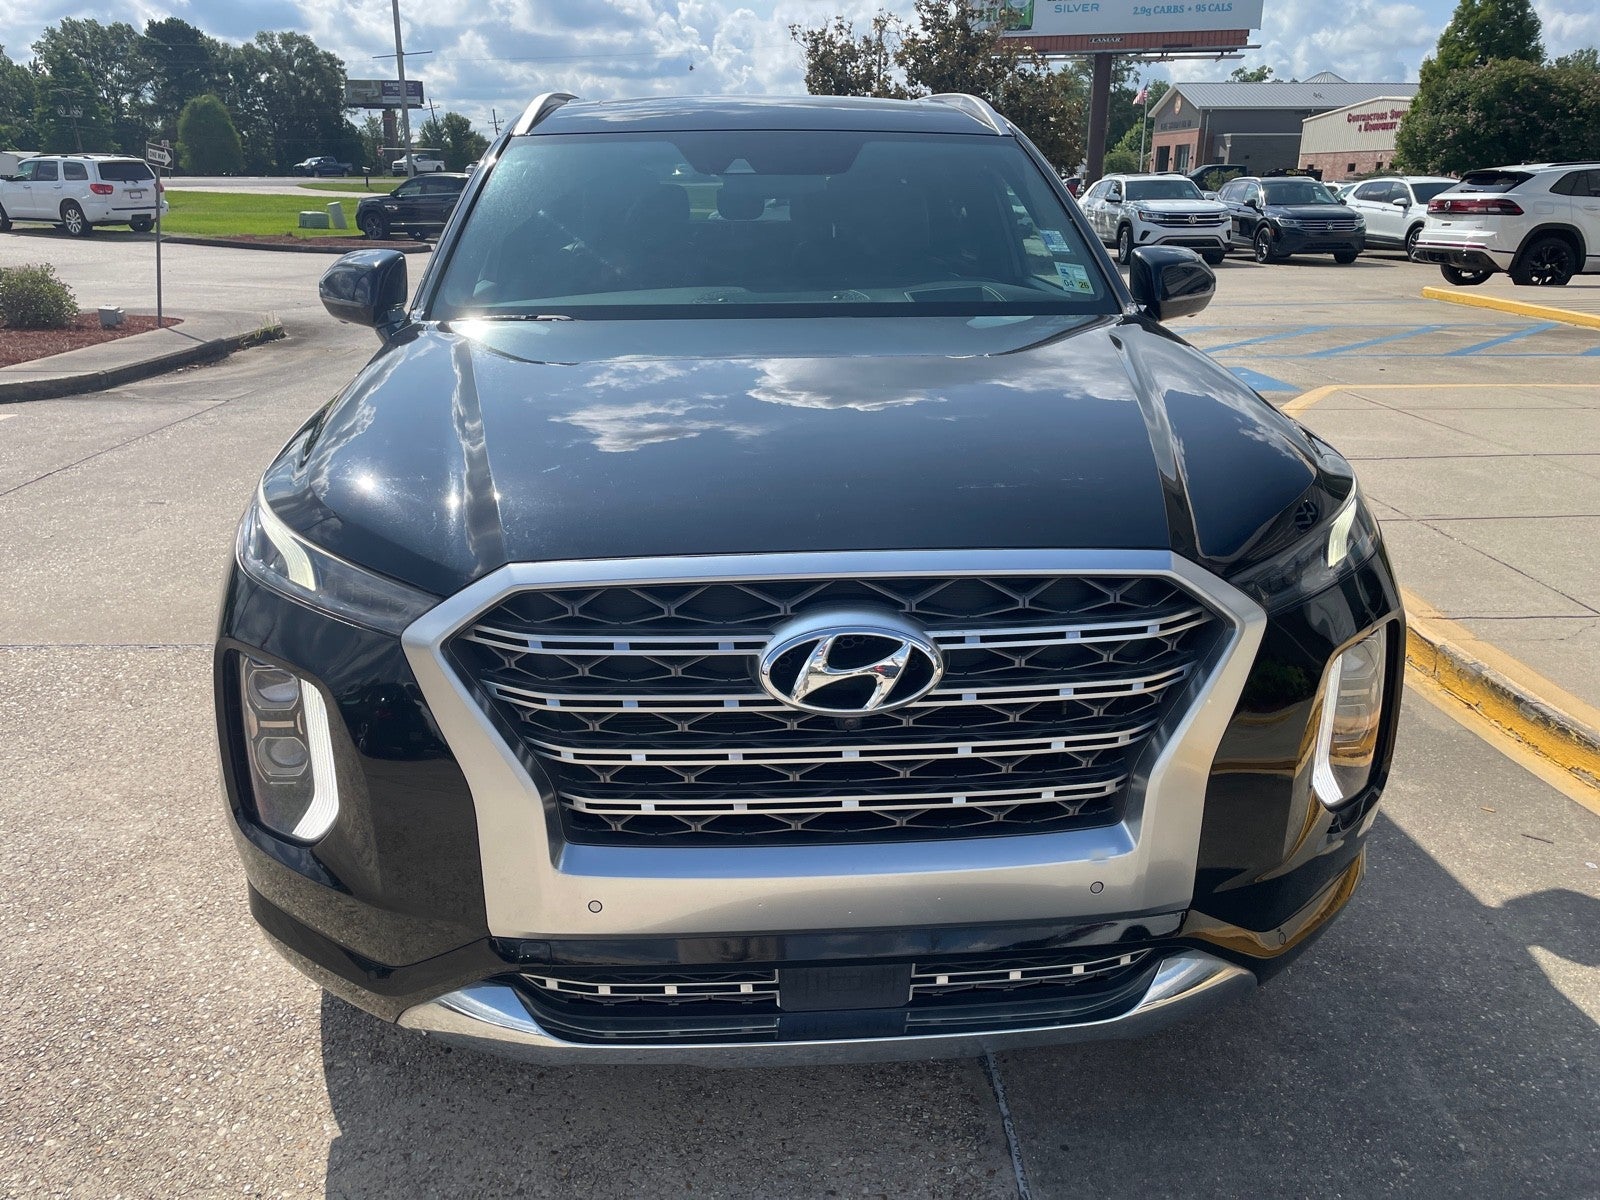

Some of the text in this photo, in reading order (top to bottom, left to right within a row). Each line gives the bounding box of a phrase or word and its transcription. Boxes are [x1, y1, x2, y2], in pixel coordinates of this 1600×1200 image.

[1054, 3, 1100, 13] SILVER
[1133, 3, 1233, 16] 2.9g CARBS 95 CALS
